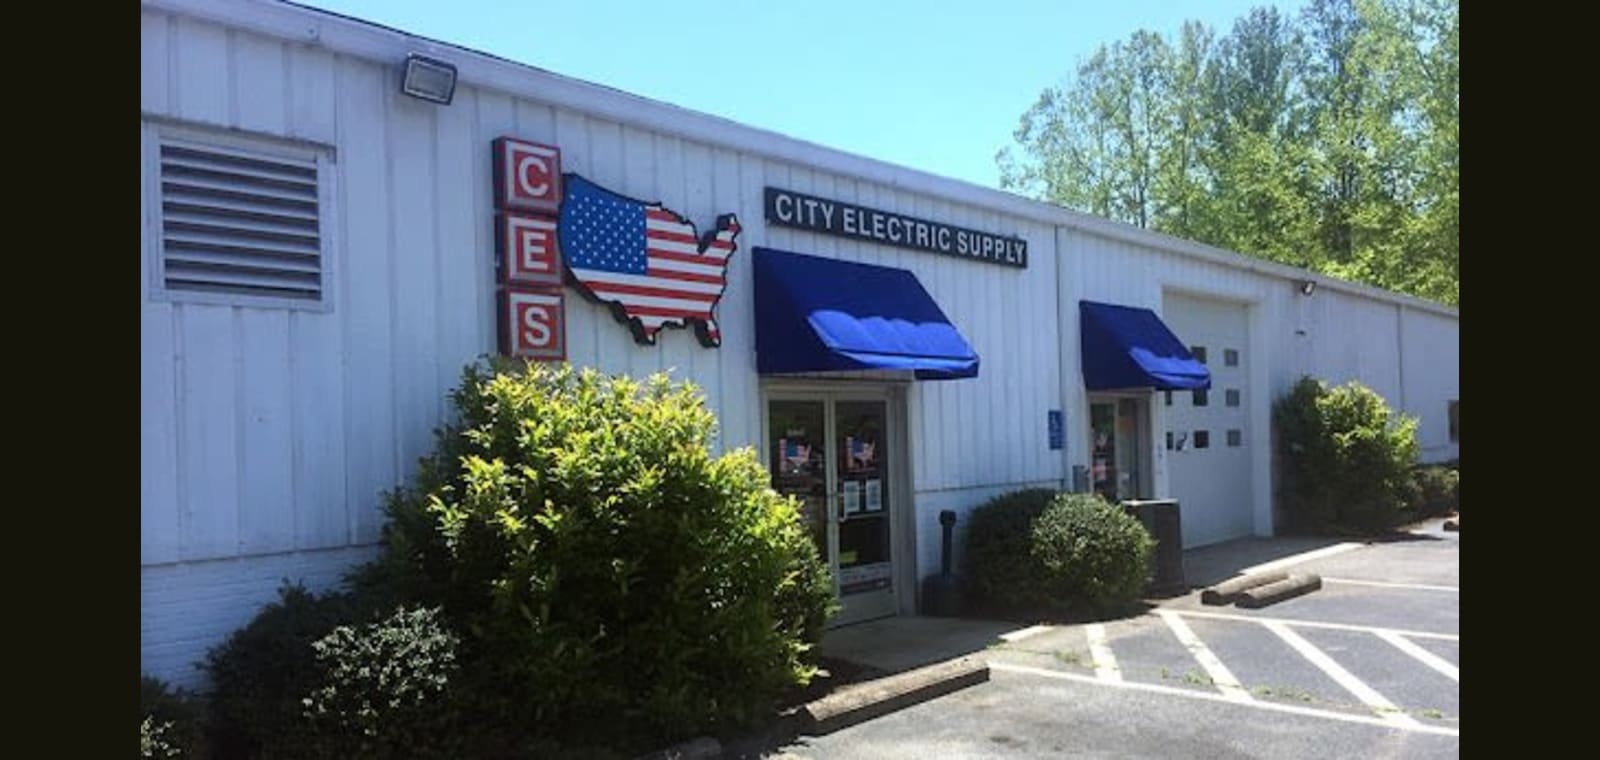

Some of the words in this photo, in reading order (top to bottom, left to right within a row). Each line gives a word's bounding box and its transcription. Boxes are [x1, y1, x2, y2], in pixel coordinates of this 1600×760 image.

[775, 194, 834, 229] CITY
[843, 208, 950, 250] ELECTRIC
[957, 231, 1025, 264] SUPPLY
